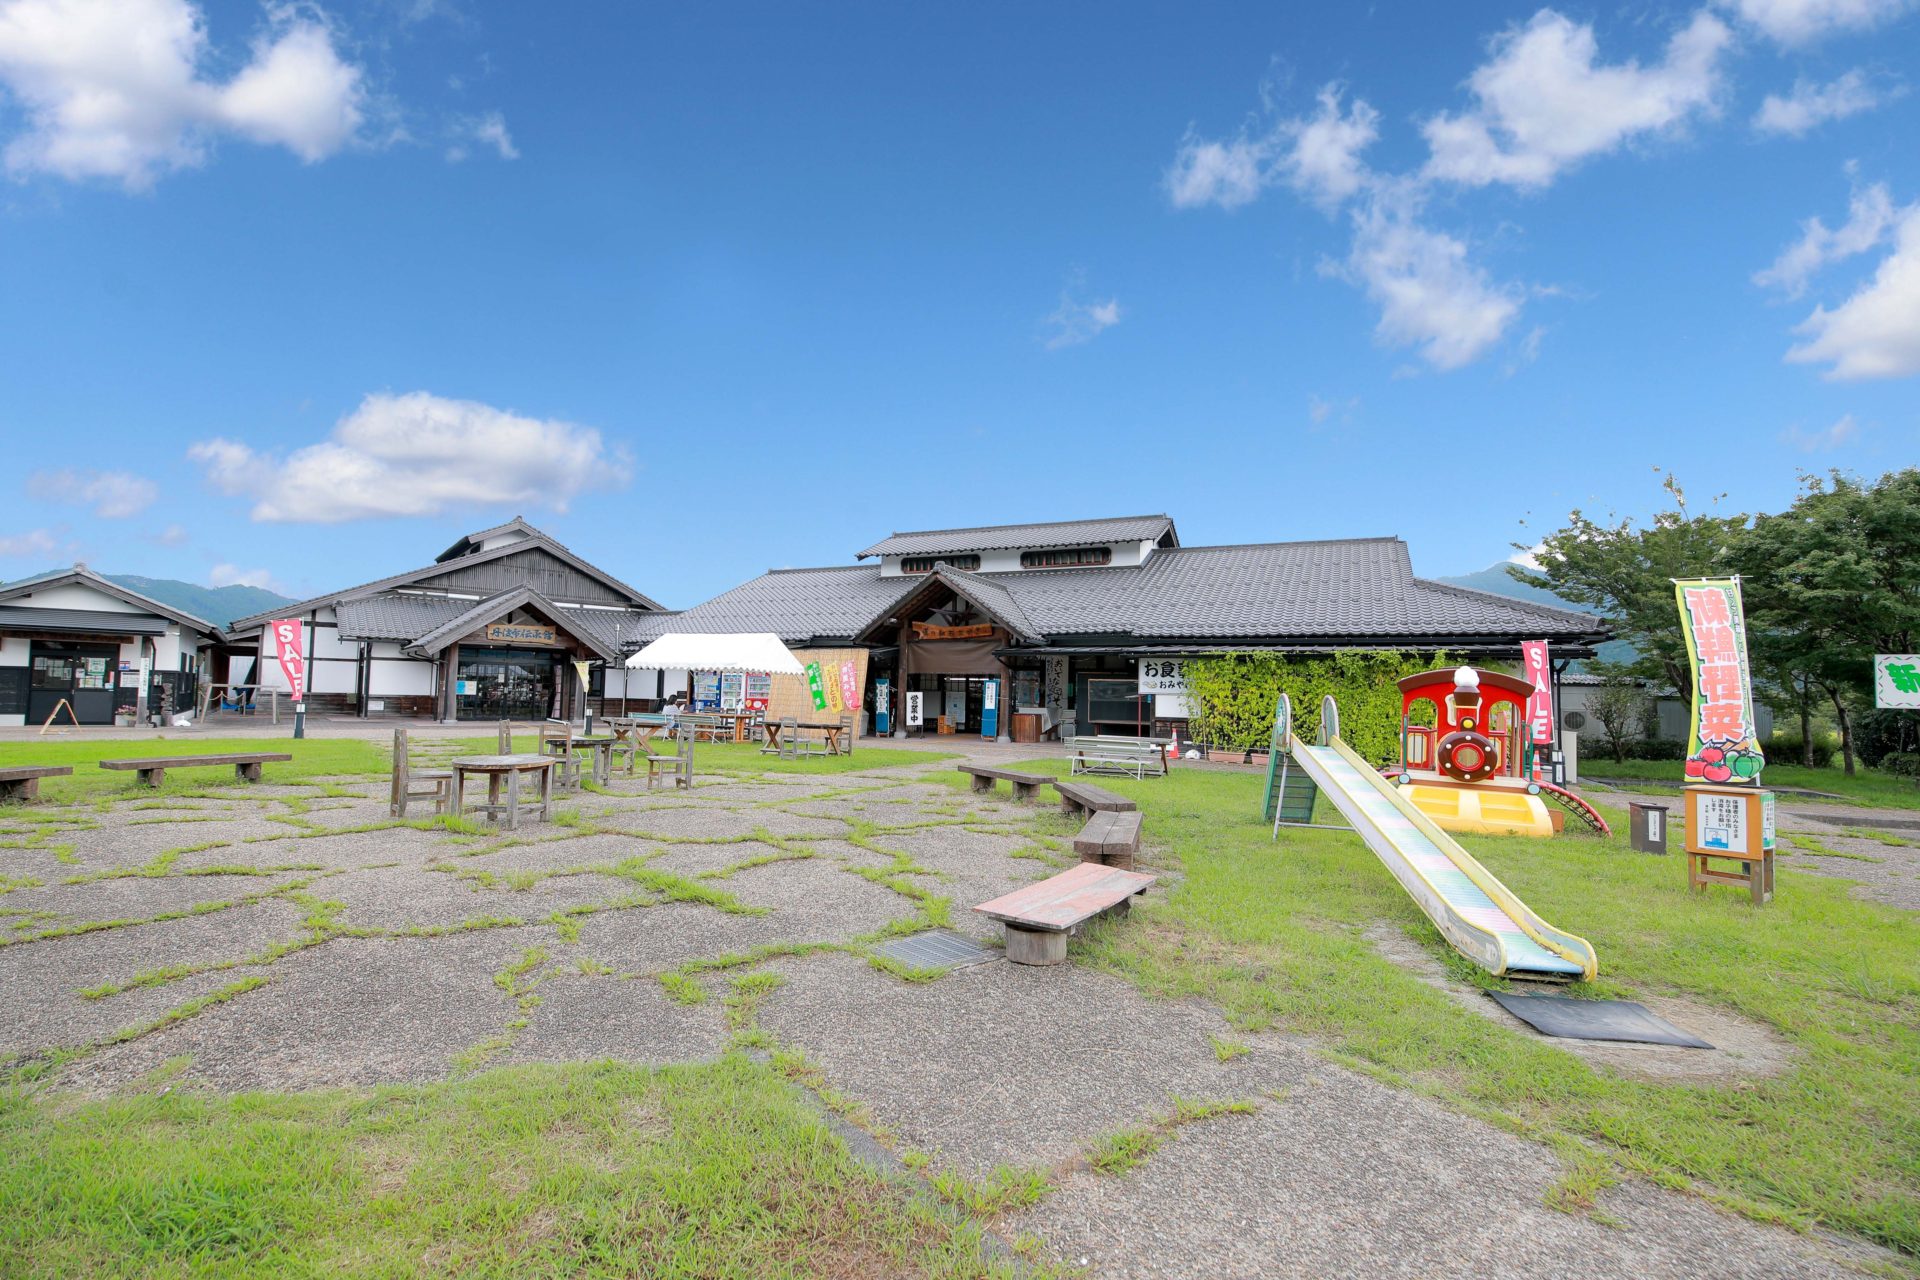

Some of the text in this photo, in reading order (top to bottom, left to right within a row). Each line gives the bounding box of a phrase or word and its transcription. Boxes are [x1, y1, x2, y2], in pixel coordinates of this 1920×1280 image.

[1160, 681, 1188, 689] おみや
[1530, 648, 1547, 739] SALE
[910, 695, 919, 723] 営業中
